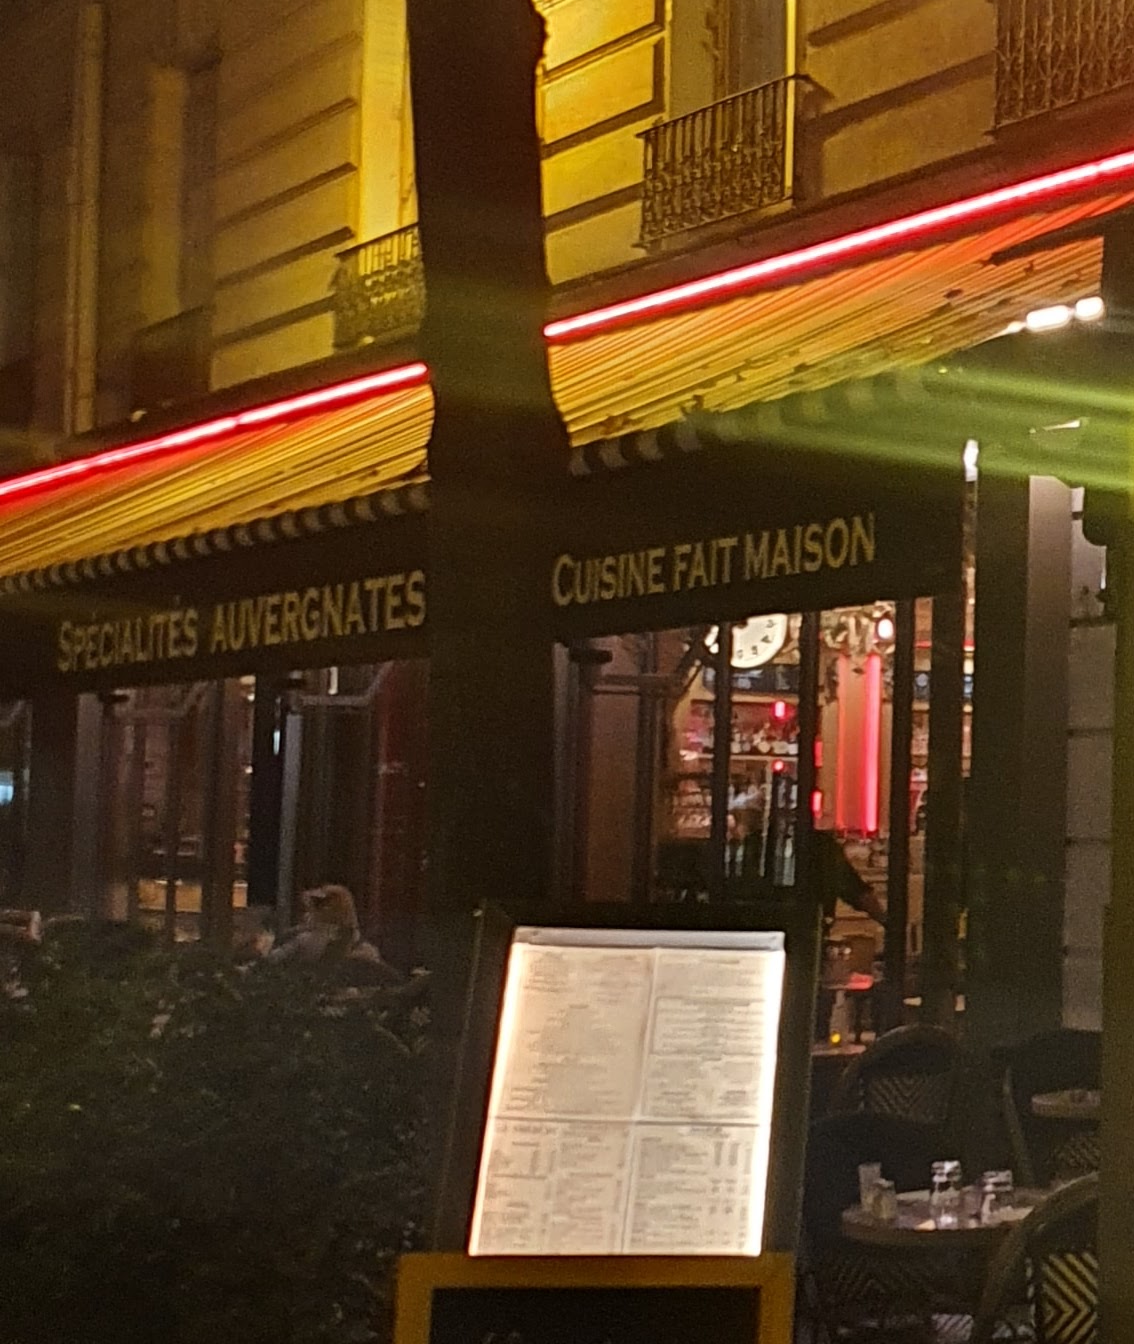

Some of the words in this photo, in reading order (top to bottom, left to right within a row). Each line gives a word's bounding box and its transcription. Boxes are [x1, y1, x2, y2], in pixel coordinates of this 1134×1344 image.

[552, 545, 666, 607] CUISINE
[672, 537, 739, 591] FAIT
[743, 513, 877, 584] MAISON
[57, 594, 198, 670] SPÉCIALITÉS
[208, 571, 427, 655] AUVERGNATES
